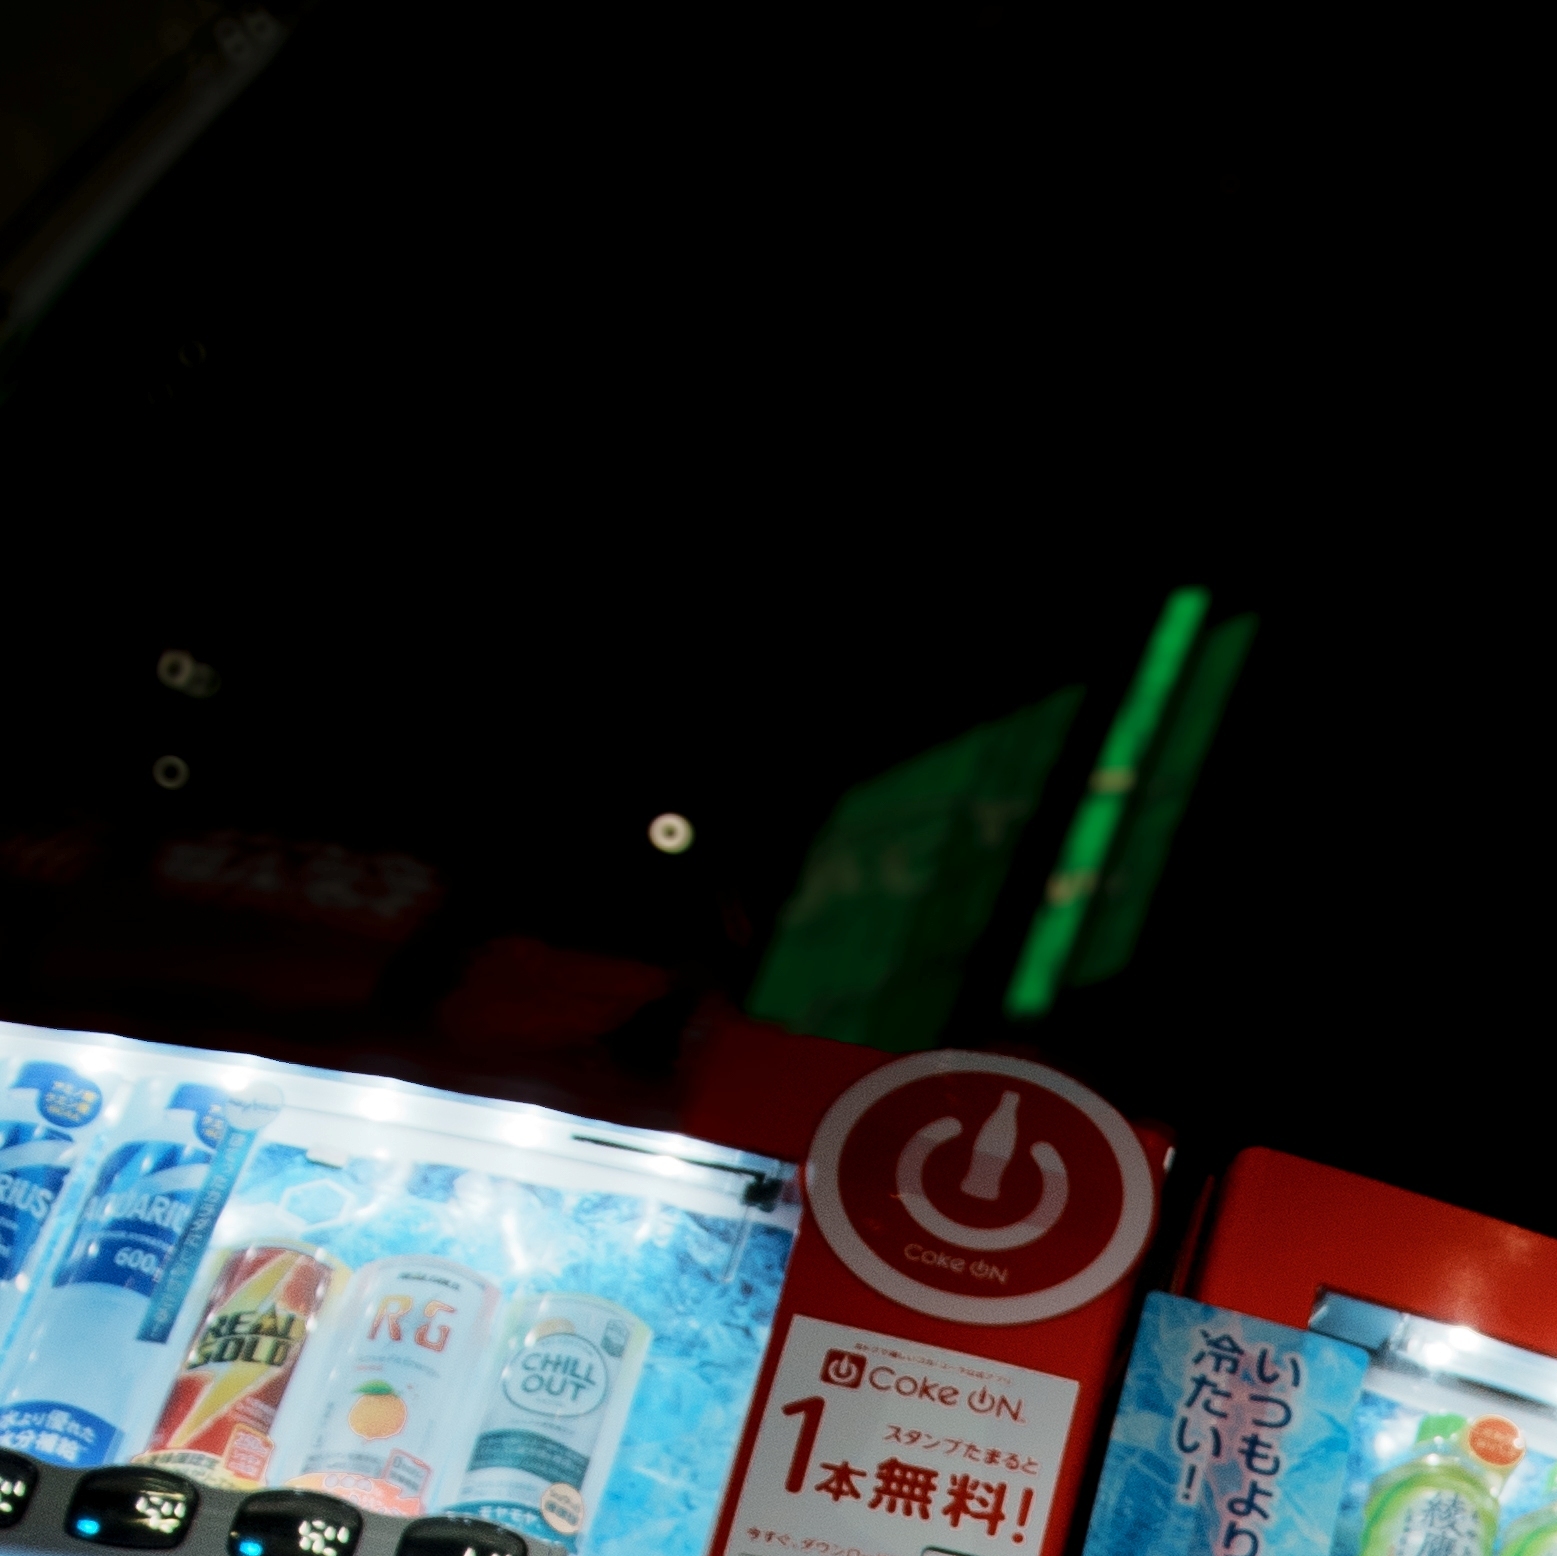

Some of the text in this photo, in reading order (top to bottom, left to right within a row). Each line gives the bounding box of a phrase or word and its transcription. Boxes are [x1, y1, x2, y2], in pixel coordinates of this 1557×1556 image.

[520, 1351, 598, 1387] CHILL
[520, 1374, 588, 1402] OUT
[868, 1365, 960, 1407] Coke
[1175, 1329, 1246, 1504] 冷たい!
[781, 1396, 1036, 1546] 1本無料!
[882, 1424, 1041, 1477] スタンプたまると
